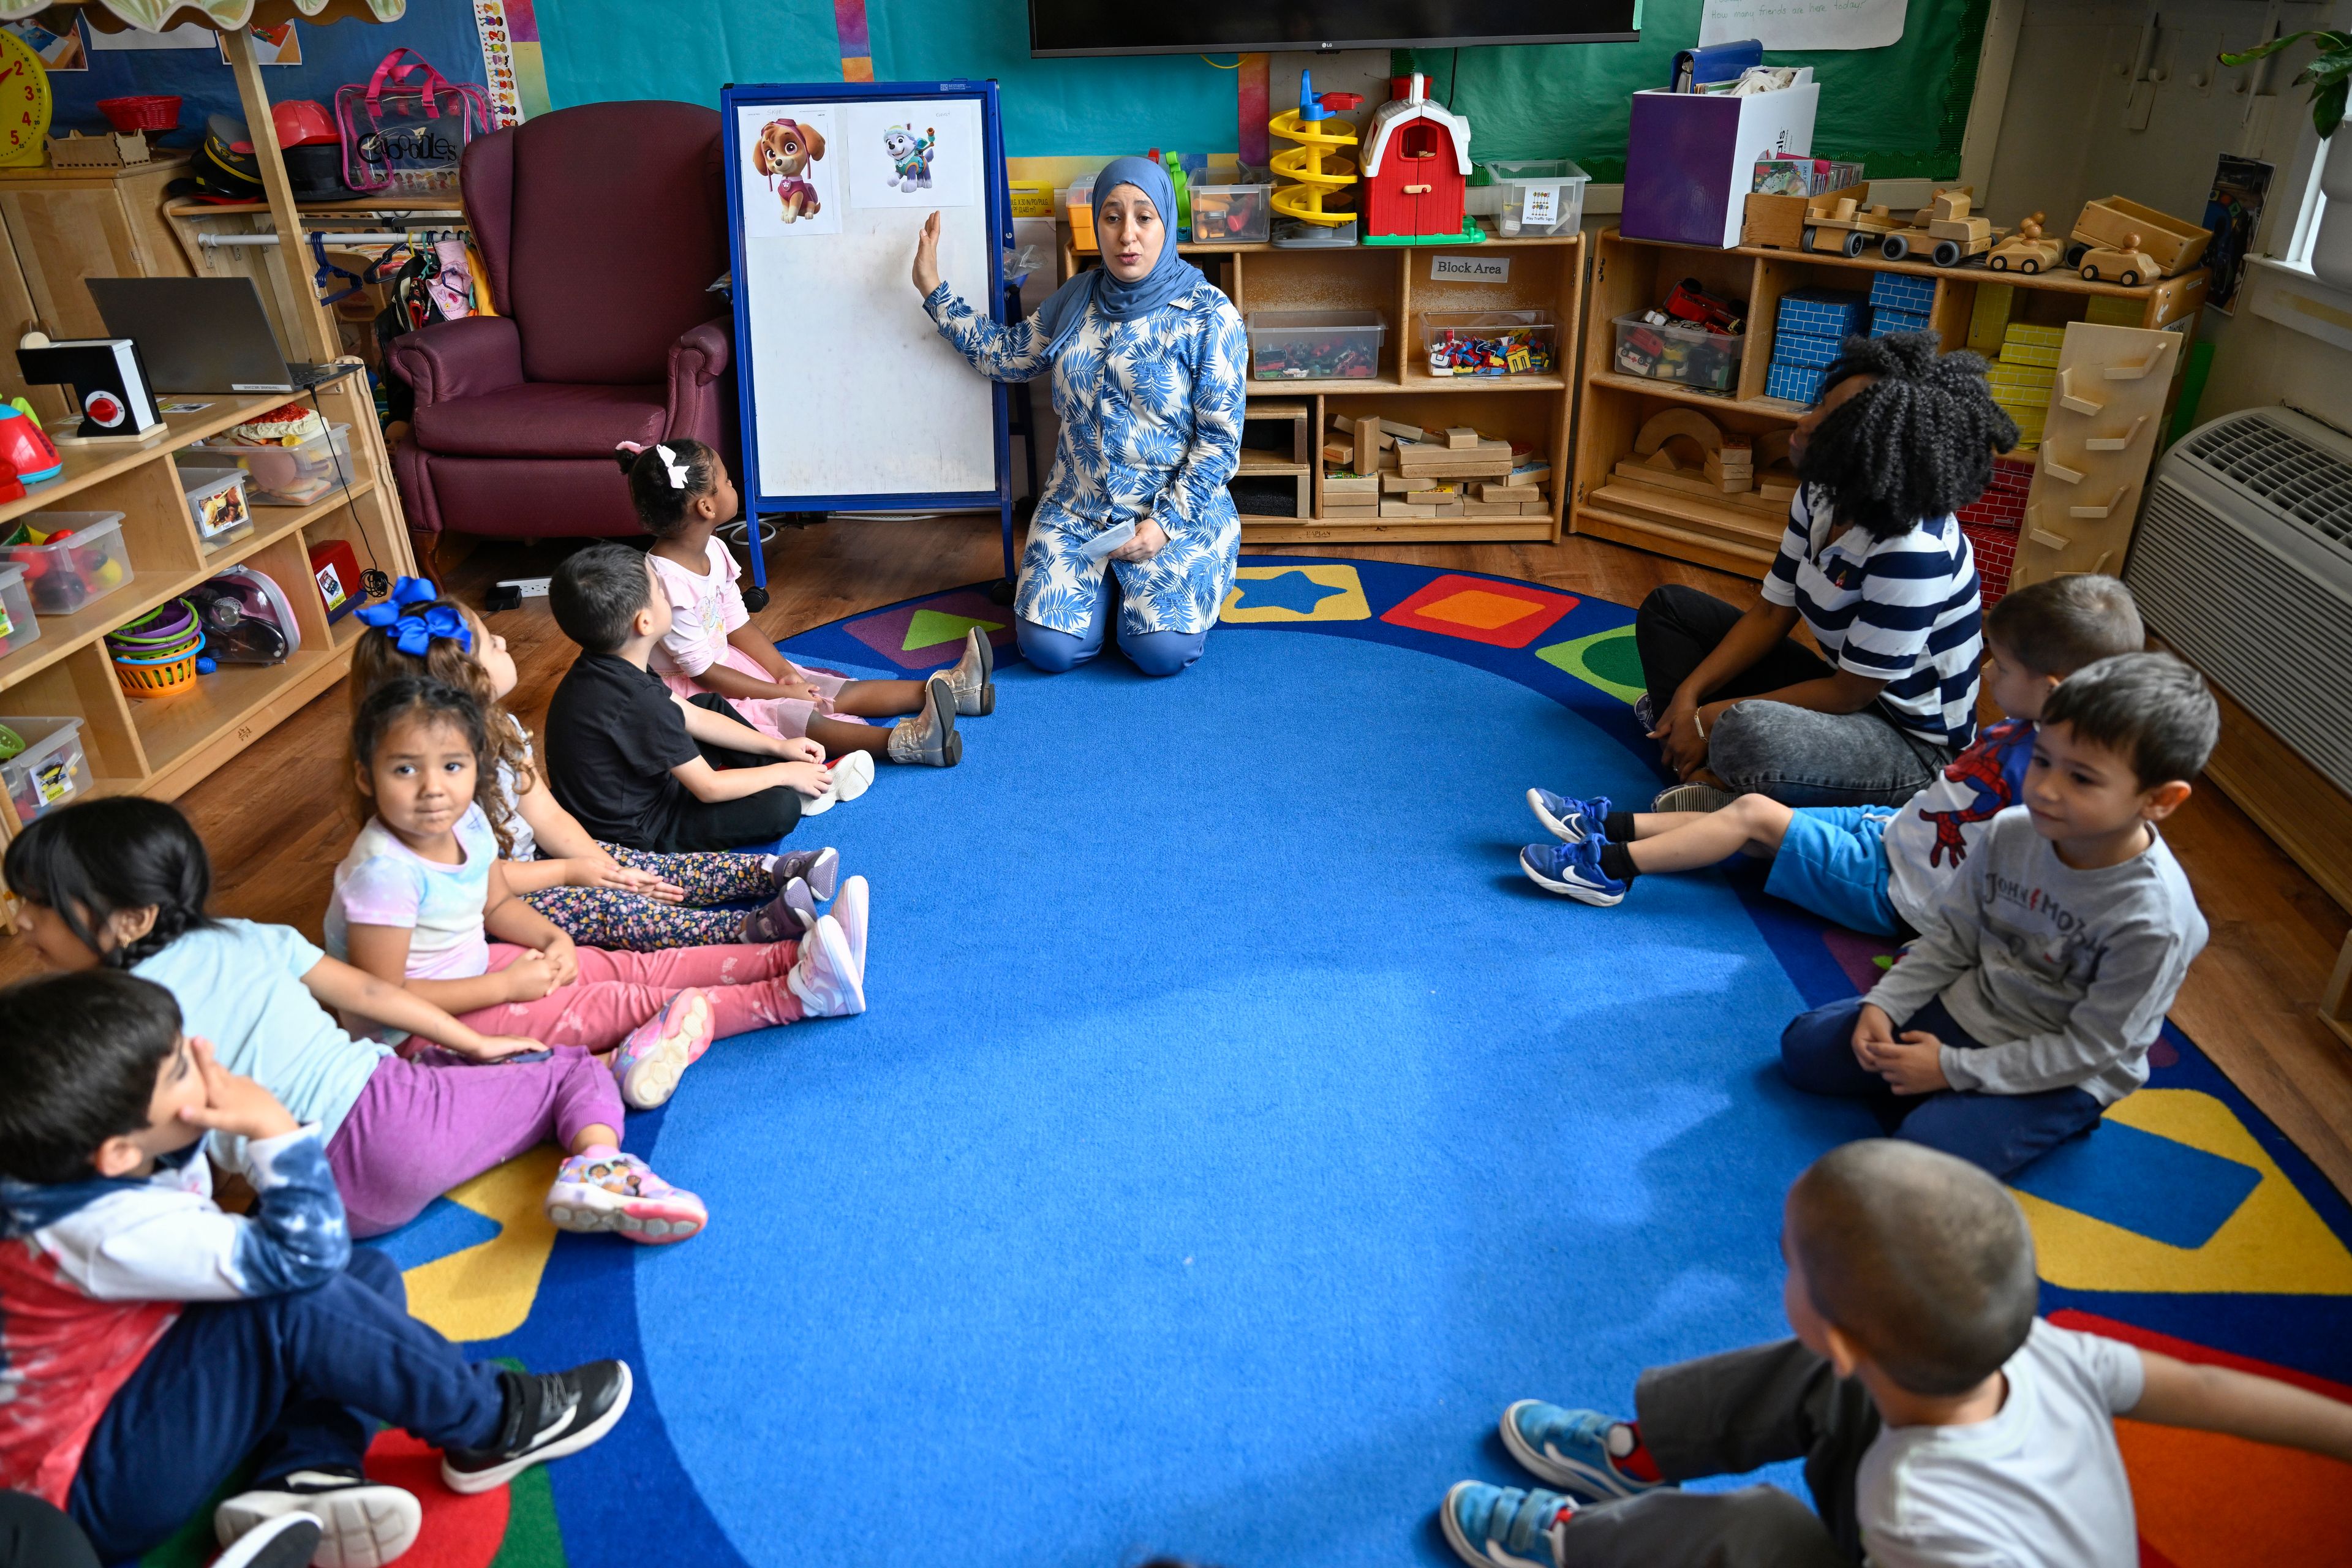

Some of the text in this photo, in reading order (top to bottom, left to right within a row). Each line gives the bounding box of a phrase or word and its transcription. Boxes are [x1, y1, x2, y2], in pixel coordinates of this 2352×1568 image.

[1734, 11, 1755, 21] many
[1759, 5, 1786, 15] friends
[1809, 3, 1827, 12] here
[14, 61, 24, 75] 2
[24, 86, 34, 101] 3
[22, 111, 31, 126] 4
[10, 130, 20, 145] 5
[1437, 261, 1502, 274] Block Area
[47, 786, 64, 801] Utensils
